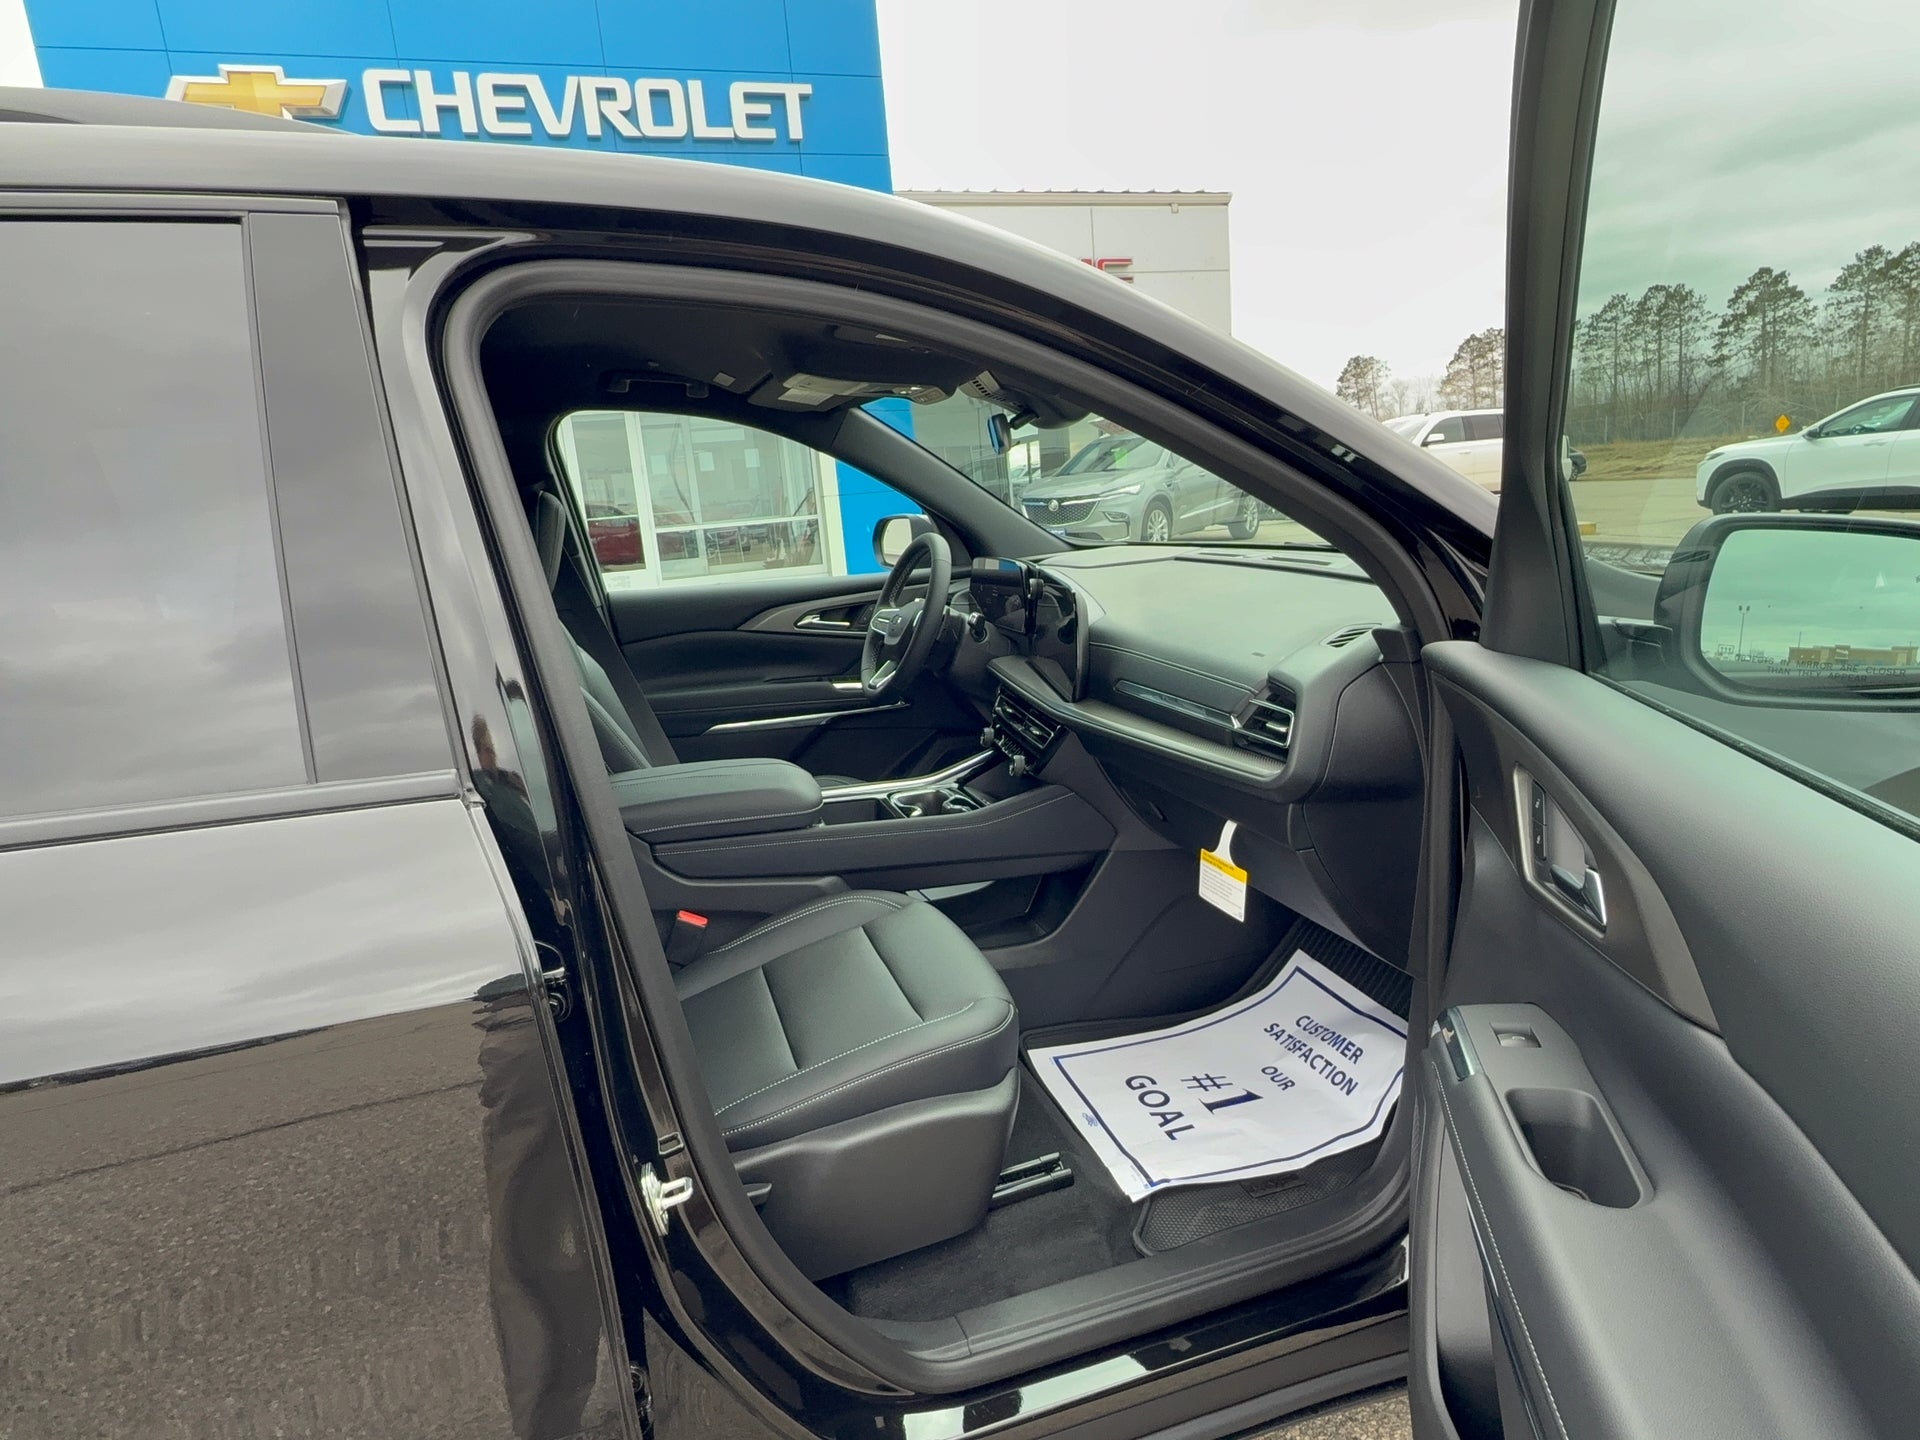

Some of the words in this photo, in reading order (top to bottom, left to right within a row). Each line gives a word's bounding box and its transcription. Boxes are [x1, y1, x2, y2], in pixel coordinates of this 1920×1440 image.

[362, 69, 812, 141] CHEVROLET
[1767, 666, 1790, 675] THAN
[1798, 669, 1822, 678] THEY
[1827, 673, 1867, 682] APPEAR
[1780, 659, 1790, 668] IN
[1796, 660, 1833, 671] MIRROR
[1839, 664, 1858, 673] ARE
[1865, 666, 1906, 677] CLOSER
[1263, 1023, 1359, 1096] SATISFACTION
[1295, 1015, 1364, 1064] CUSTOMER
[1180, 1073, 1264, 1115] #1
[1261, 1066, 1296, 1091] OUR
[1125, 1075, 1195, 1141] GOAL
